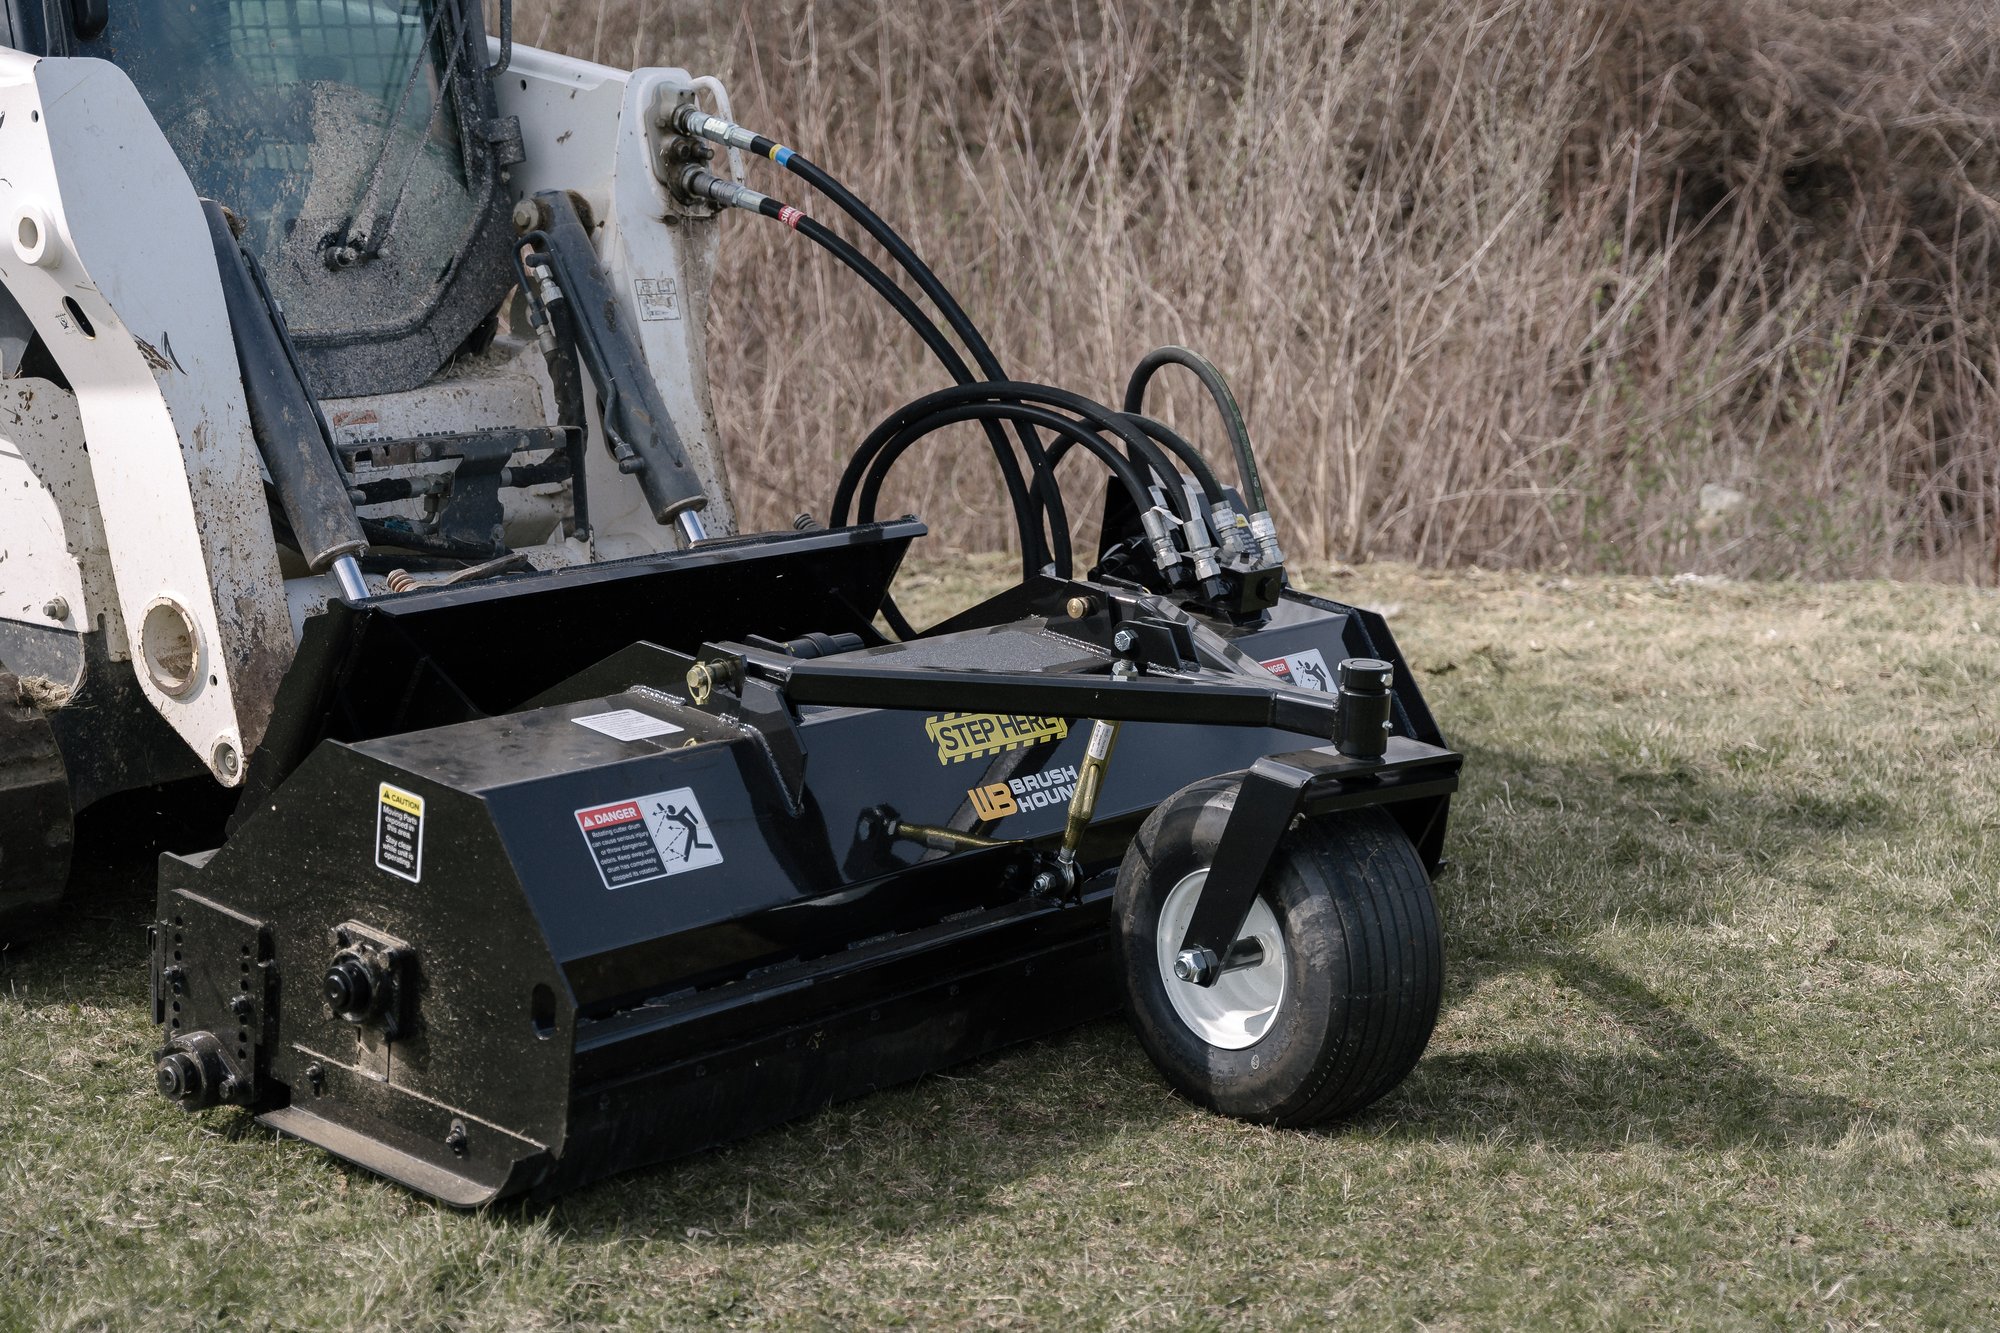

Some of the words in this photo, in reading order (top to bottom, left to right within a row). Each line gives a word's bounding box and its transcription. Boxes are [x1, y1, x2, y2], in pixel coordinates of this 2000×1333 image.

[939, 718, 995, 751] STEP
[1008, 765, 1079, 795] BRUSH
[391, 794, 420, 811] CAUTION
[1016, 782, 1077, 813] HOUN
[382, 805, 403, 821] Moving
[403, 812, 418, 826] Parts
[384, 815, 410, 831] exposed
[408, 823, 415, 832] in
[594, 807, 637, 825] DANGER
[386, 823, 397, 834] this
[591, 829, 613, 838] Rotating
[613, 825, 627, 834] cutter
[627, 823, 640, 831] drum
[385, 834, 398, 847] Stay
[397, 840, 412, 852] clear
[601, 838, 617, 846] cause
[617, 835, 635, 843] serious
[635, 831, 649, 840] injury
[621, 840, 648, 851] dangerous
[382, 843, 397, 854] while
[397, 849, 409, 859] unit
[408, 852, 414, 861] is
[617, 853, 631, 862] Keep
[631, 850, 644, 858] away
[644, 847, 655, 855] until
[606, 866, 620, 874] drum
[629, 857, 657, 868] completely
[611, 872, 633, 882] stopped
